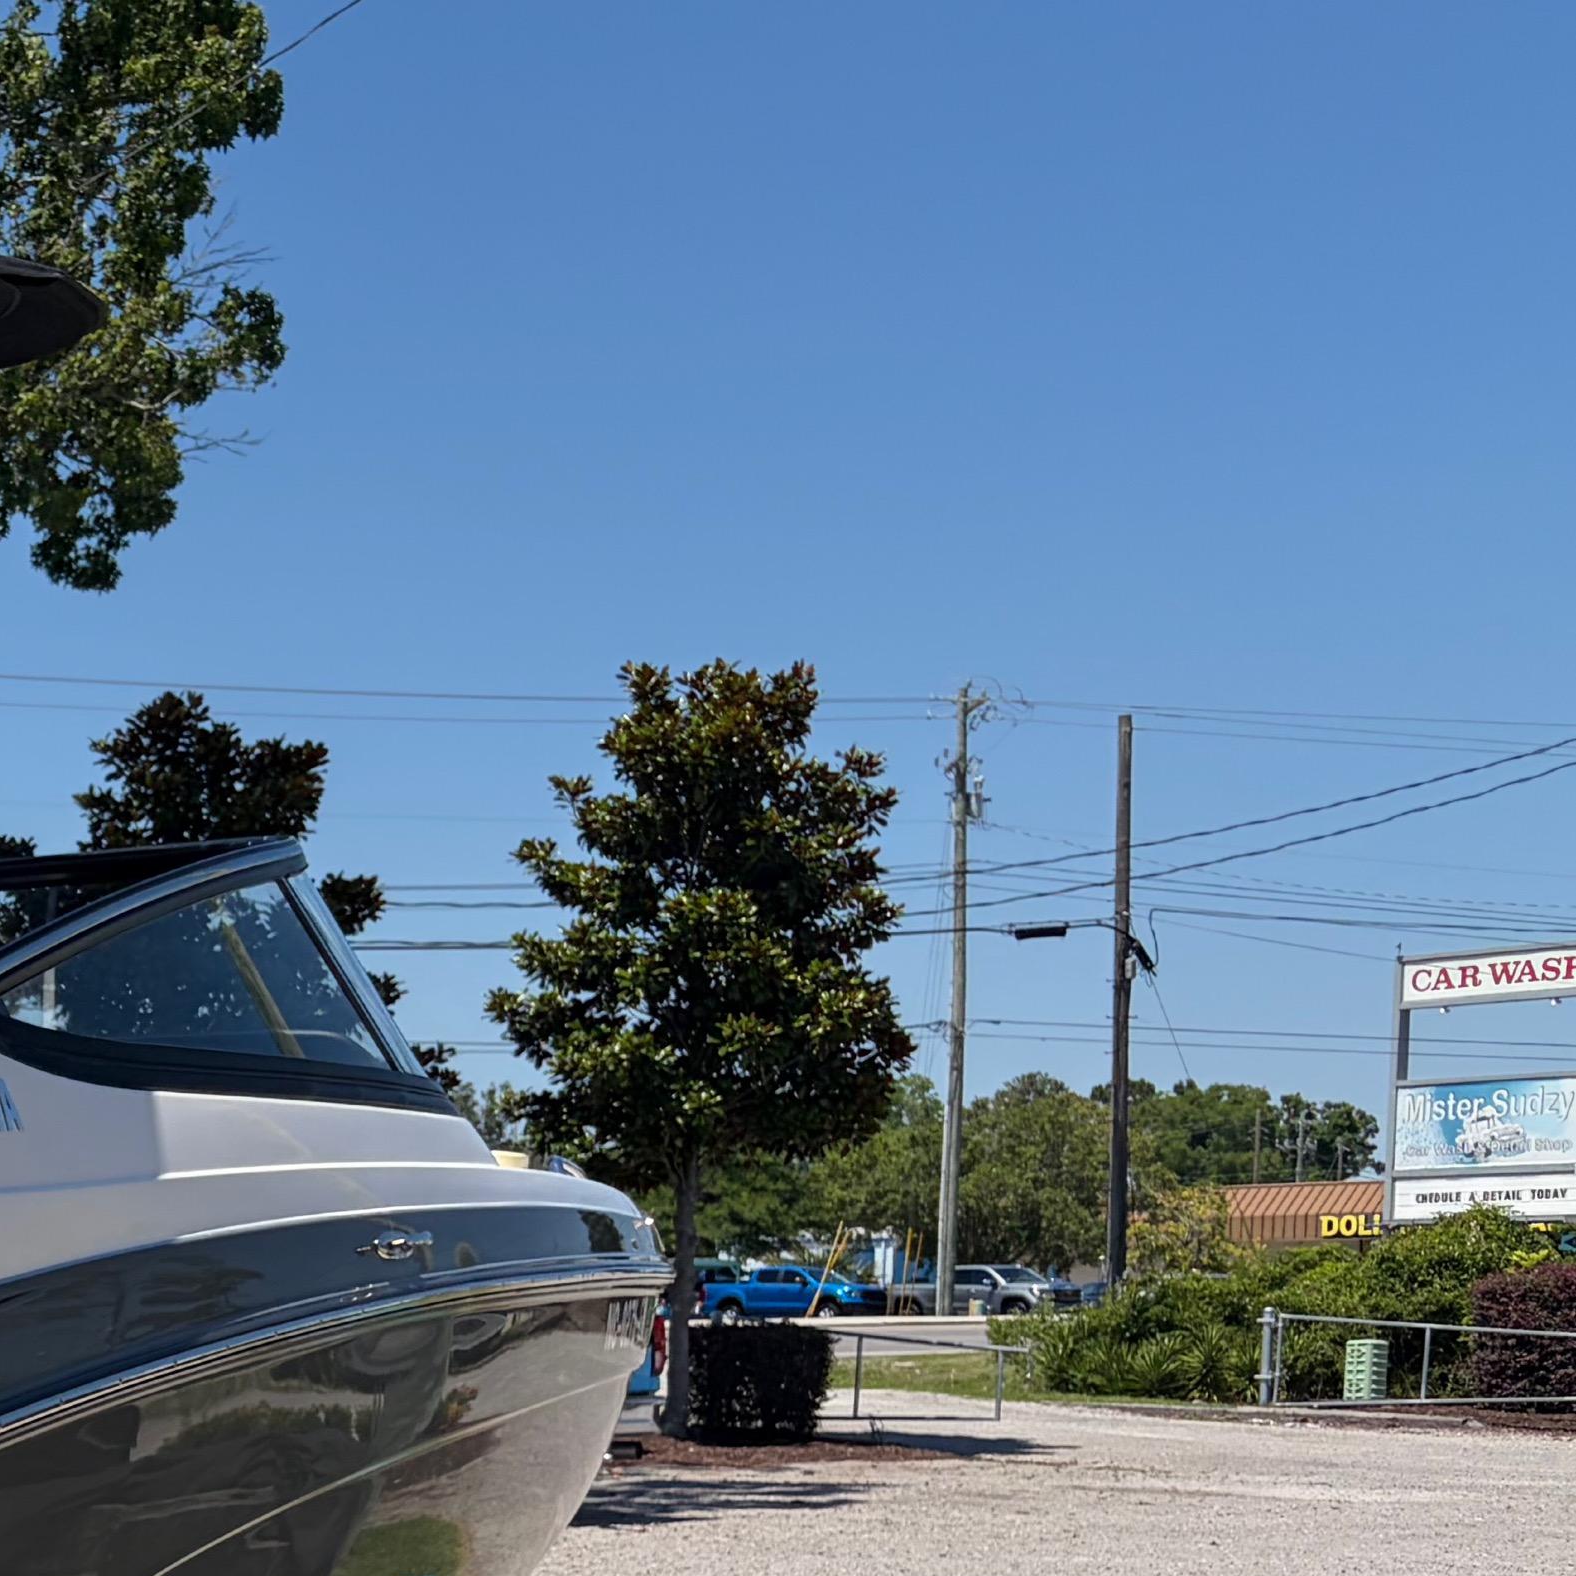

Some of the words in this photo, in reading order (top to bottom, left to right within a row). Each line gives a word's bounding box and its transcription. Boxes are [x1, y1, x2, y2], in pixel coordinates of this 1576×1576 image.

[1411, 964, 1482, 992] CAR
[1406, 1091, 1486, 1122] Mister
[1482, 1189, 1522, 1202] DETAIL
[1531, 1188, 1568, 1200] TODAY
